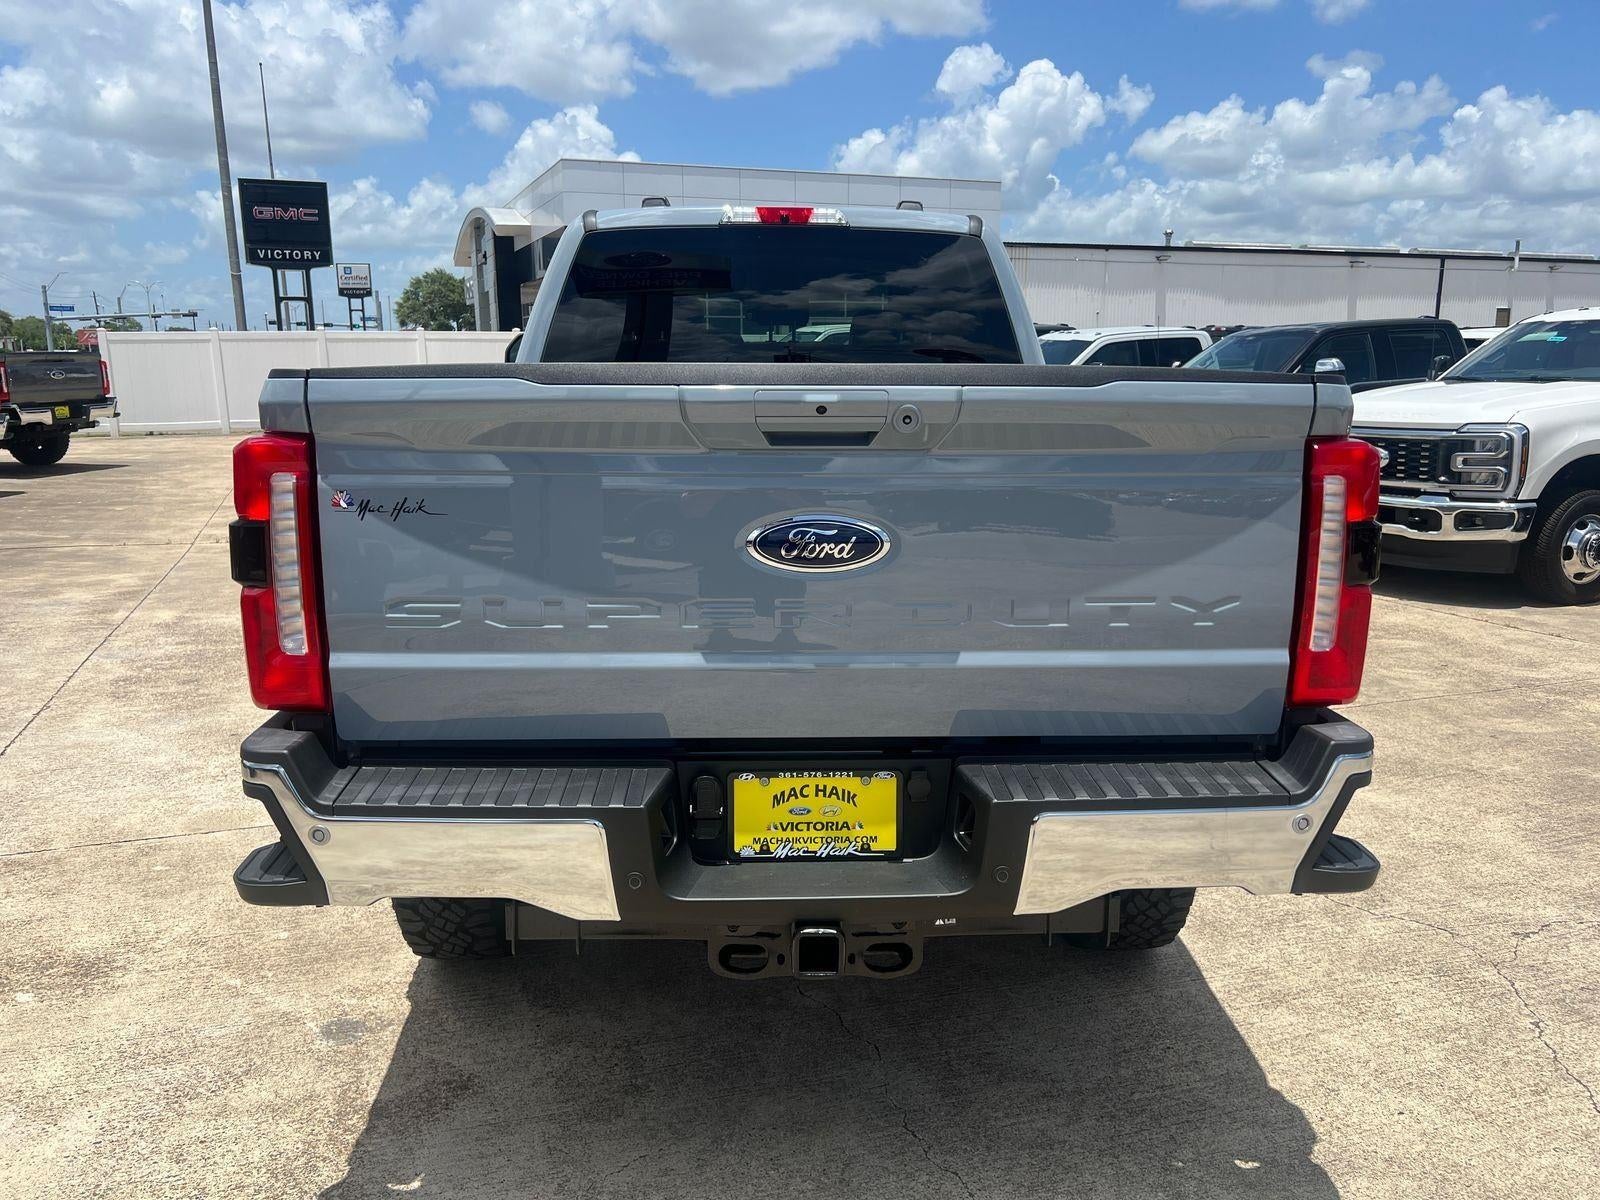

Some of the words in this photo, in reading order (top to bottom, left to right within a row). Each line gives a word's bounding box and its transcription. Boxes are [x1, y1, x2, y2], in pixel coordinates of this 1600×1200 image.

[253, 206, 319, 221] GMC
[257, 249, 321, 260] VICTORY
[355, 499, 389, 521] Mac
[390, 497, 448, 522] Haik
[780, 527, 857, 559] Ford
[384, 596, 853, 629] SUPER
[896, 595, 1241, 628] DUTY
[772, 784, 810, 809] MAC
[814, 783, 858, 808] HAIK
[779, 821, 851, 832] VICTORIA
[772, 842, 815, 859] Mac
[816, 841, 884, 858] Haik
